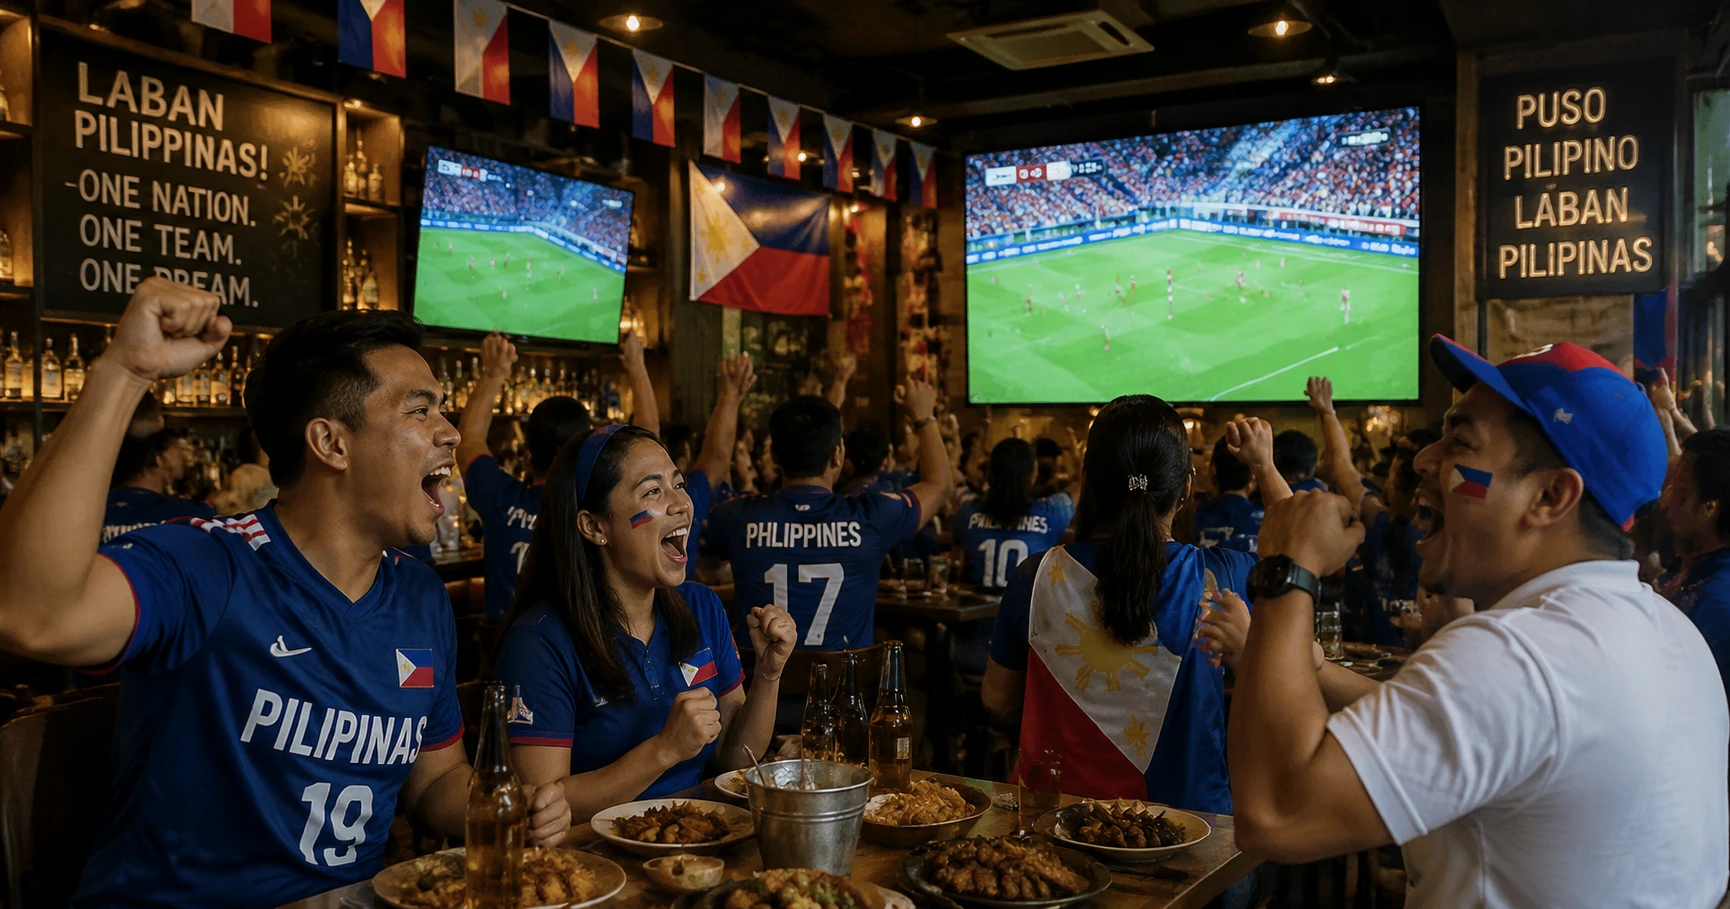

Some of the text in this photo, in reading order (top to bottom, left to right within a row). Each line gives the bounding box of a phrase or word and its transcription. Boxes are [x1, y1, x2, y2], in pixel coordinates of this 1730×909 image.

[78, 61, 225, 132] LABAN
[1516, 86, 1607, 130] PUSO
[74, 110, 269, 181] PILIPPINAS!
[1503, 134, 1640, 181] PILIPINO
[152, 180, 257, 227] NATION.
[79, 213, 242, 266] ONE TEAM.
[1498, 236, 1653, 280] PILIPINAS
[79, 257, 142, 295] ONE
[746, 521, 862, 549] PHLIPPINES
[978, 538, 1029, 588] 10
[764, 562, 845, 647] 17
[240, 688, 428, 766] PILIPINAS
[299, 781, 374, 867] 19
